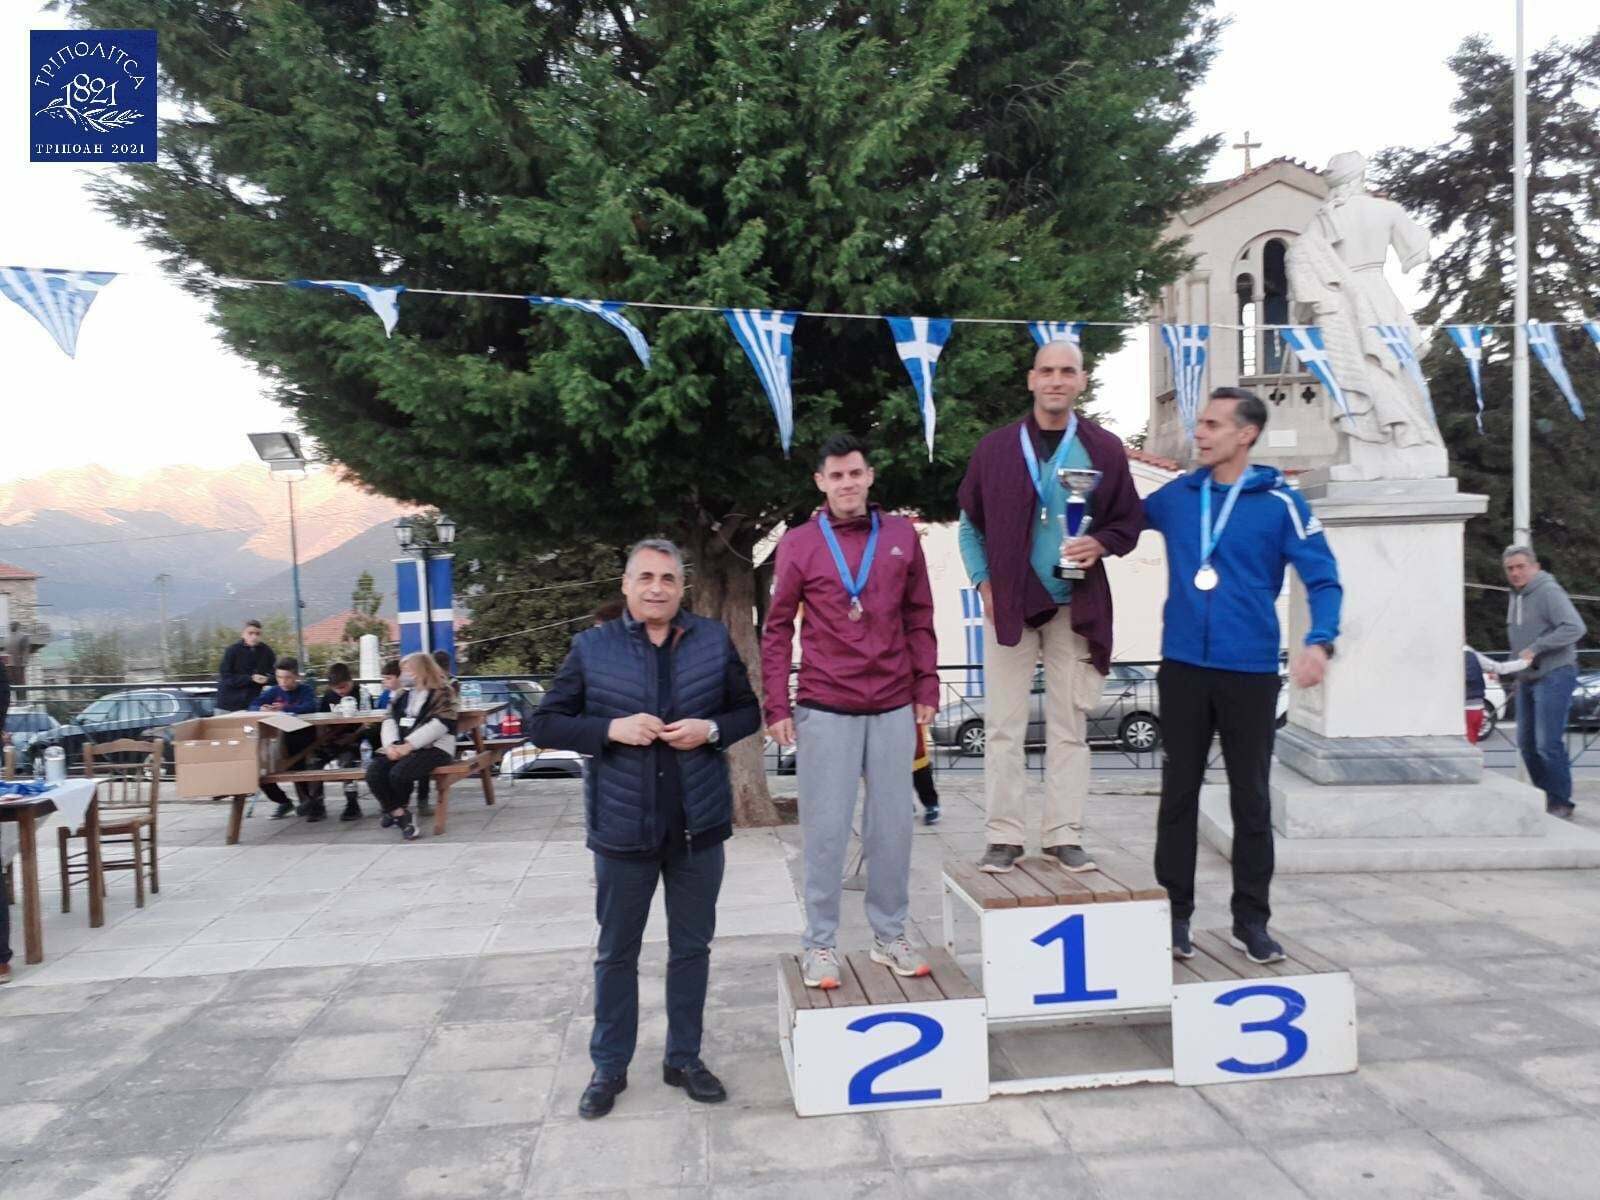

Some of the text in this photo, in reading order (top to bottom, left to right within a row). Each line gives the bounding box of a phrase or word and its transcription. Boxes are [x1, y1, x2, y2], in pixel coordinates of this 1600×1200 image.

[1030, 914, 1117, 1005] 1
[846, 1012, 945, 1106] 2
[1213, 984, 1308, 1074] 3
